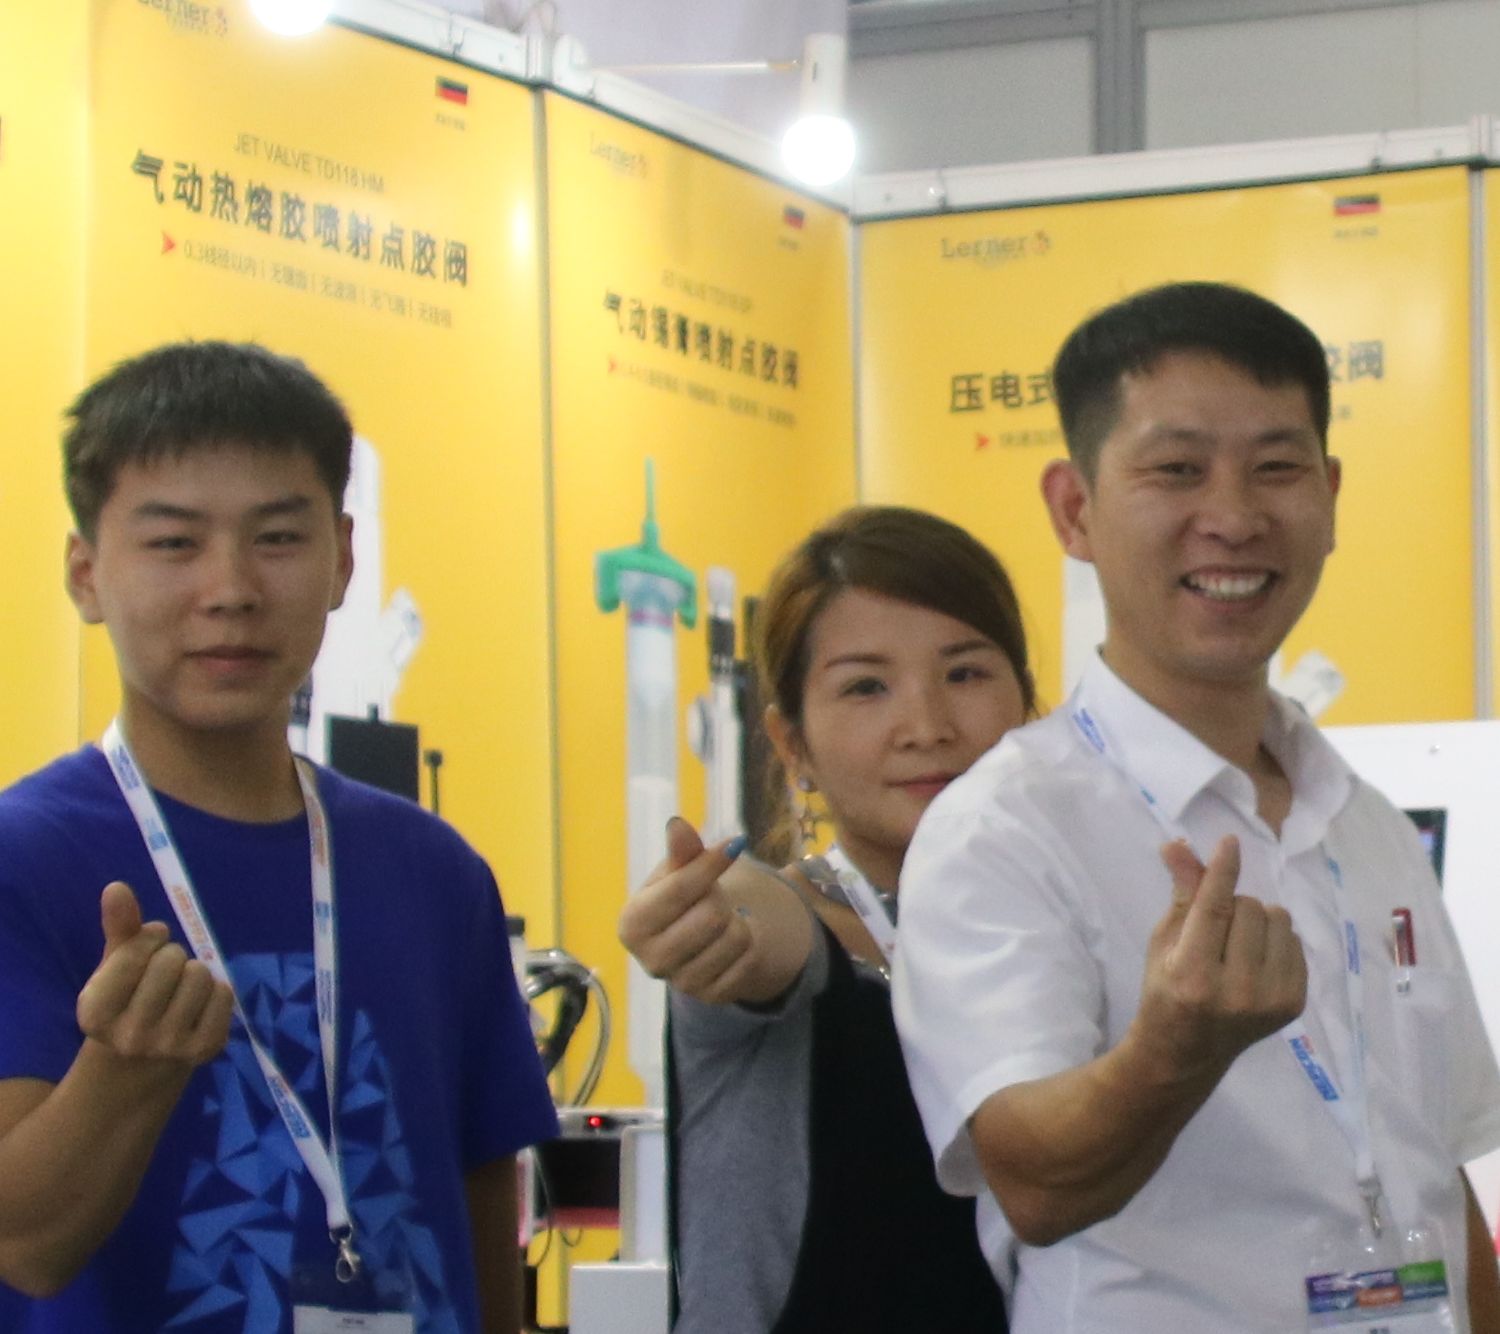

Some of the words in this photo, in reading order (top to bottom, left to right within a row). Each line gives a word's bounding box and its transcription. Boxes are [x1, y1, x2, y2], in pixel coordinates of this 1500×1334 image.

[233, 132, 260, 157] JET
[263, 138, 311, 173] VALVE
[131, 149, 468, 288] 气动热熔胶喷射点胶阀
